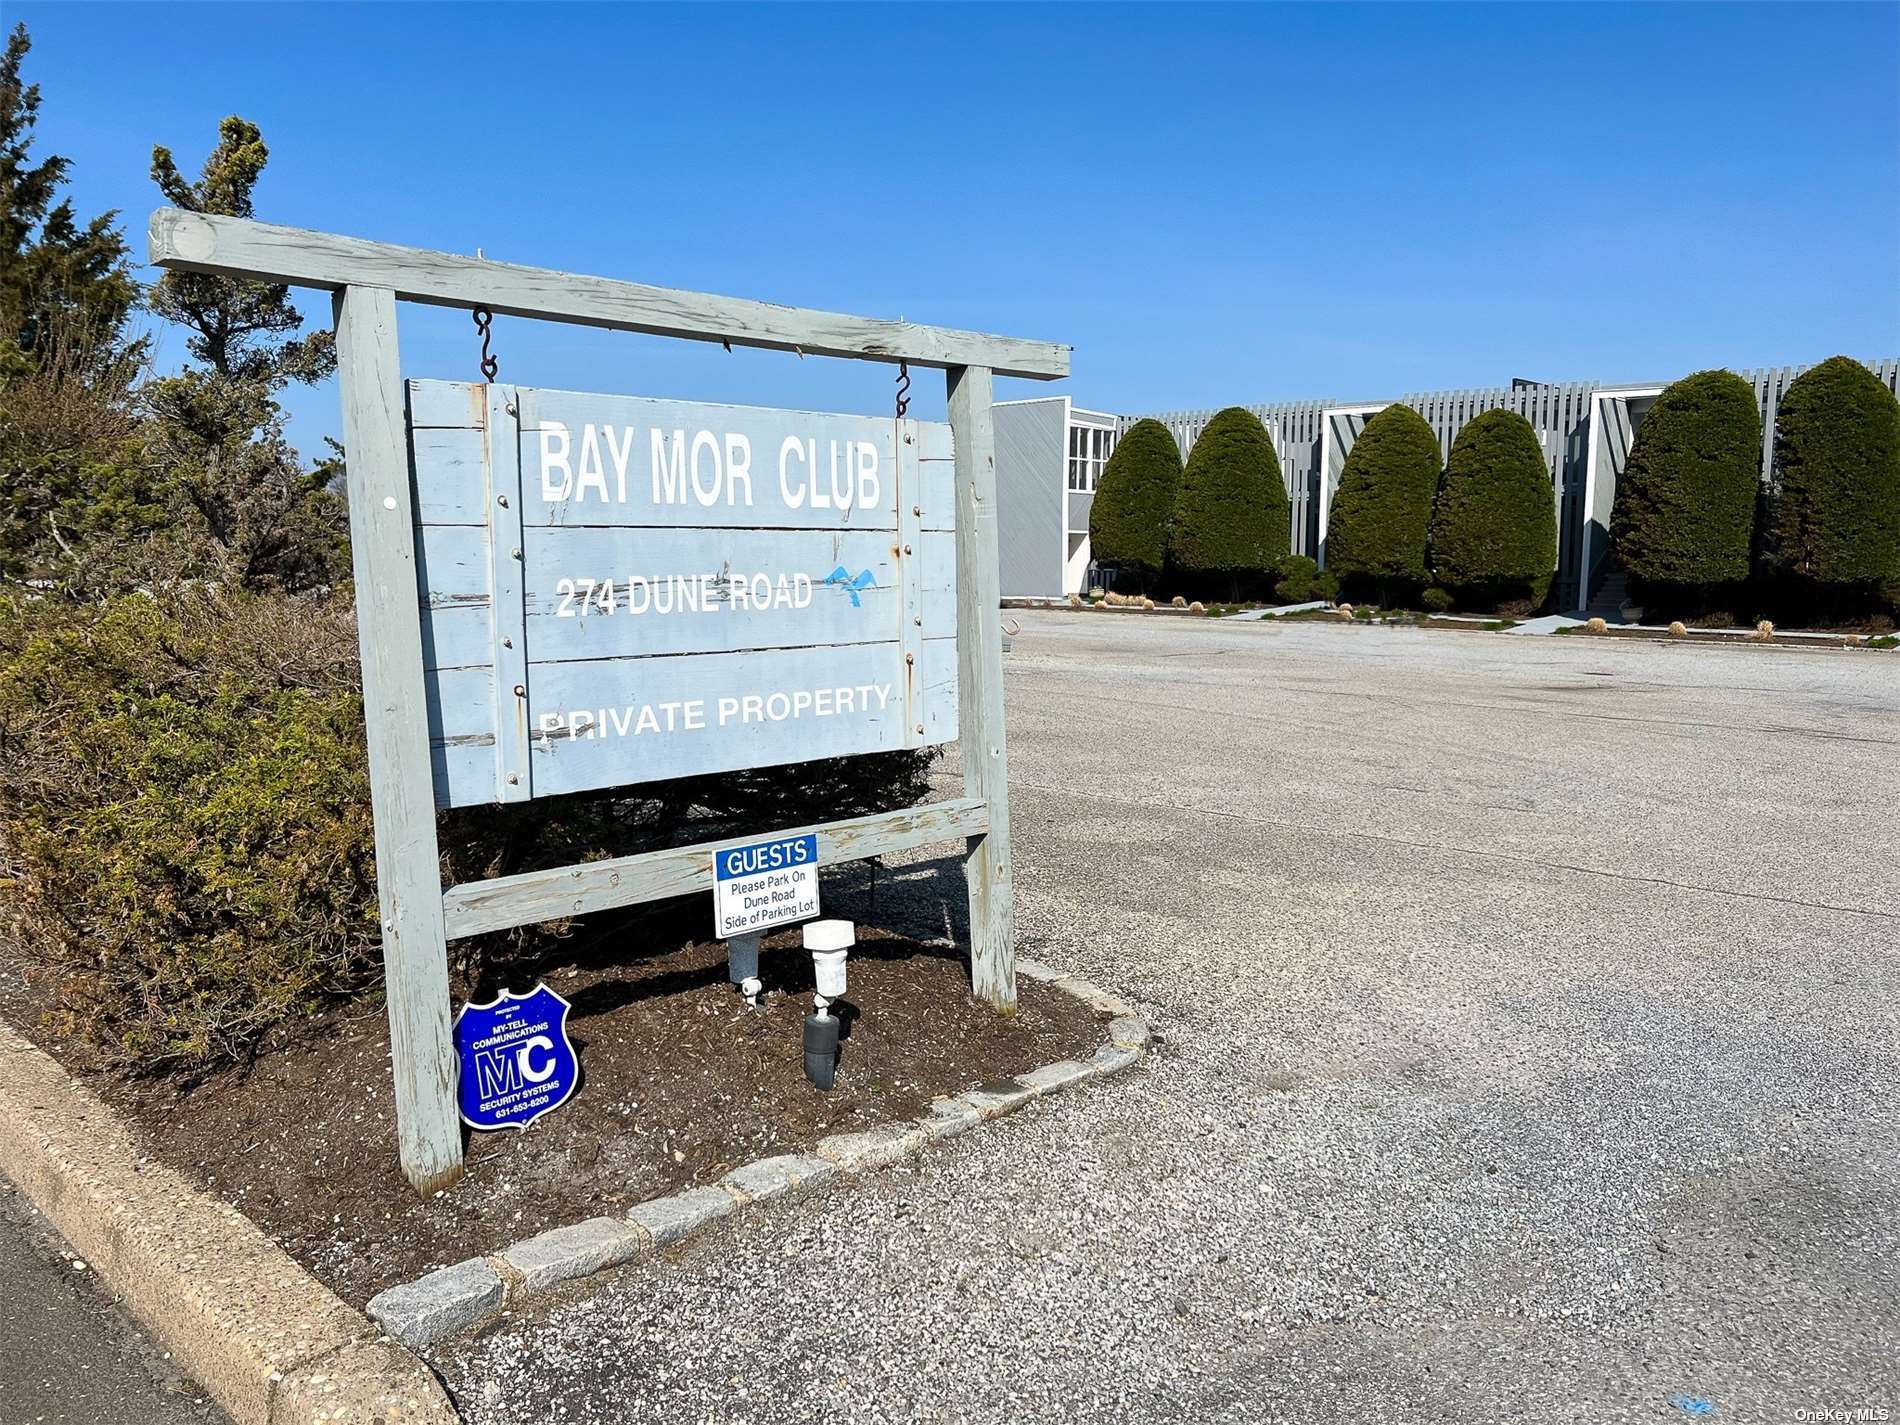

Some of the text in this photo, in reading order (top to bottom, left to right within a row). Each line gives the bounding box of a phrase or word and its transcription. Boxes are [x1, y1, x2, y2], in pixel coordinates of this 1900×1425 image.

[539, 420, 881, 510] BAY MOR CLUB
[555, 572, 813, 618] 274 DUNE ROAD
[538, 683, 893, 745] PRIVATE PROPERTY
[727, 839, 807, 875] GUESTS
[731, 871, 806, 896] Please Park On
[744, 888, 796, 909] Dune Road
[725, 899, 814, 930] Side of Parking Lot
[472, 1021, 549, 1050] COMMUNICATIONS
[492, 1018, 529, 1035] MY-TELL
[479, 1080, 560, 1112] SECURITY SYSTEMS
[495, 1095, 550, 1119] 631-653-8200
